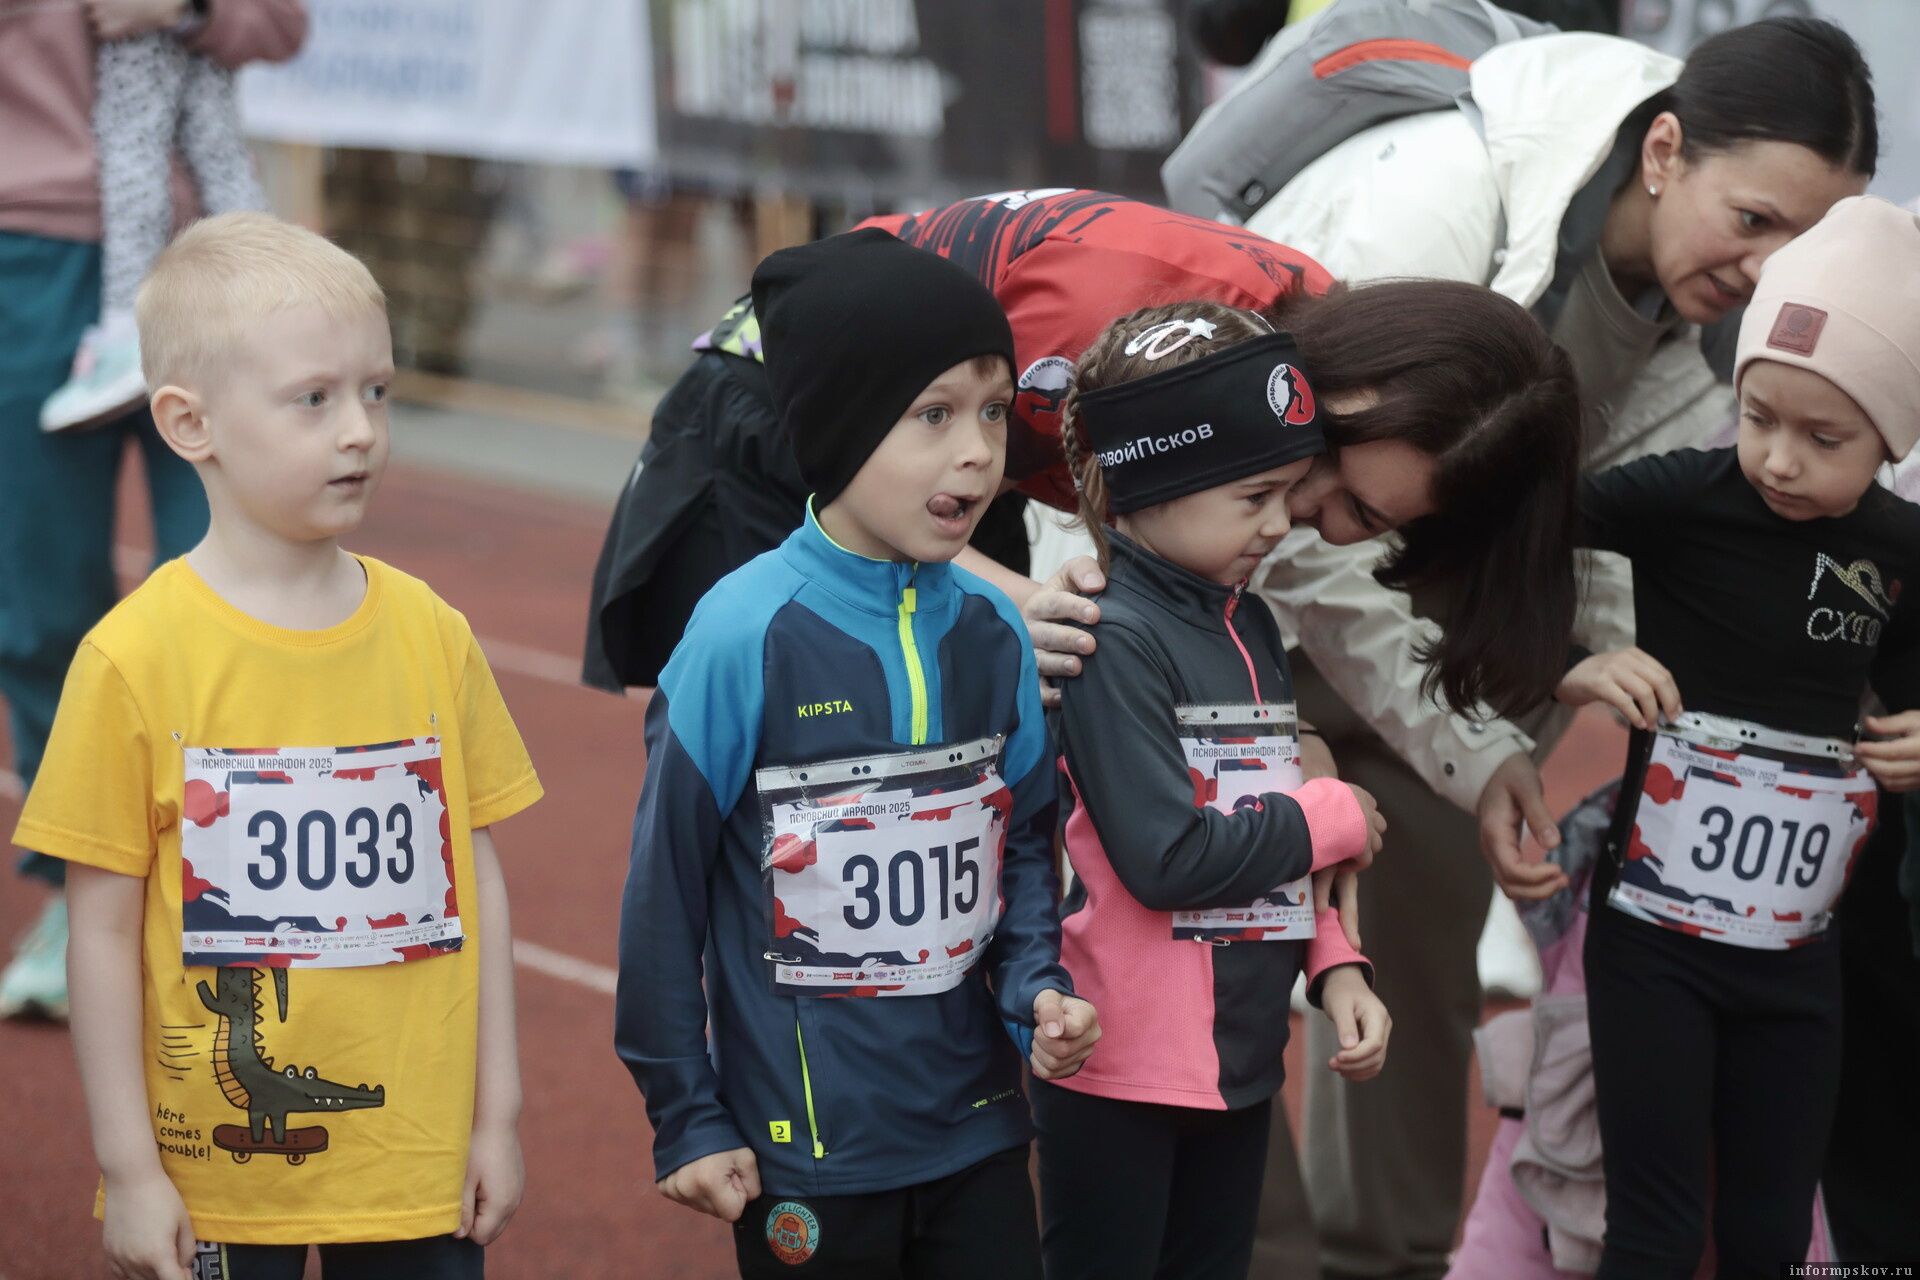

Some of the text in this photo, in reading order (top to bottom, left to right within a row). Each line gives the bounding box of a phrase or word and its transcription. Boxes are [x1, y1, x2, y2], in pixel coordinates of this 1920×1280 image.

[1097, 423, 1214, 467] овойПсков
[798, 700, 853, 718] KIPSTA
[1240, 746, 1276, 757] МАРАФОН
[1277, 745, 1293, 756] 2025
[258, 758, 306, 769] МАРАФОН
[309, 758, 333, 768] 2025
[842, 804, 886, 817] МАРАФОН
[889, 801, 911, 814] 2025
[247, 802, 415, 891] 3033
[1691, 806, 1830, 888] 3019
[842, 836, 980, 930] 3015
[156, 1102, 185, 1124] here
[160, 1125, 201, 1140] comes
[771, 1204, 817, 1231] PACK LIGHTER
